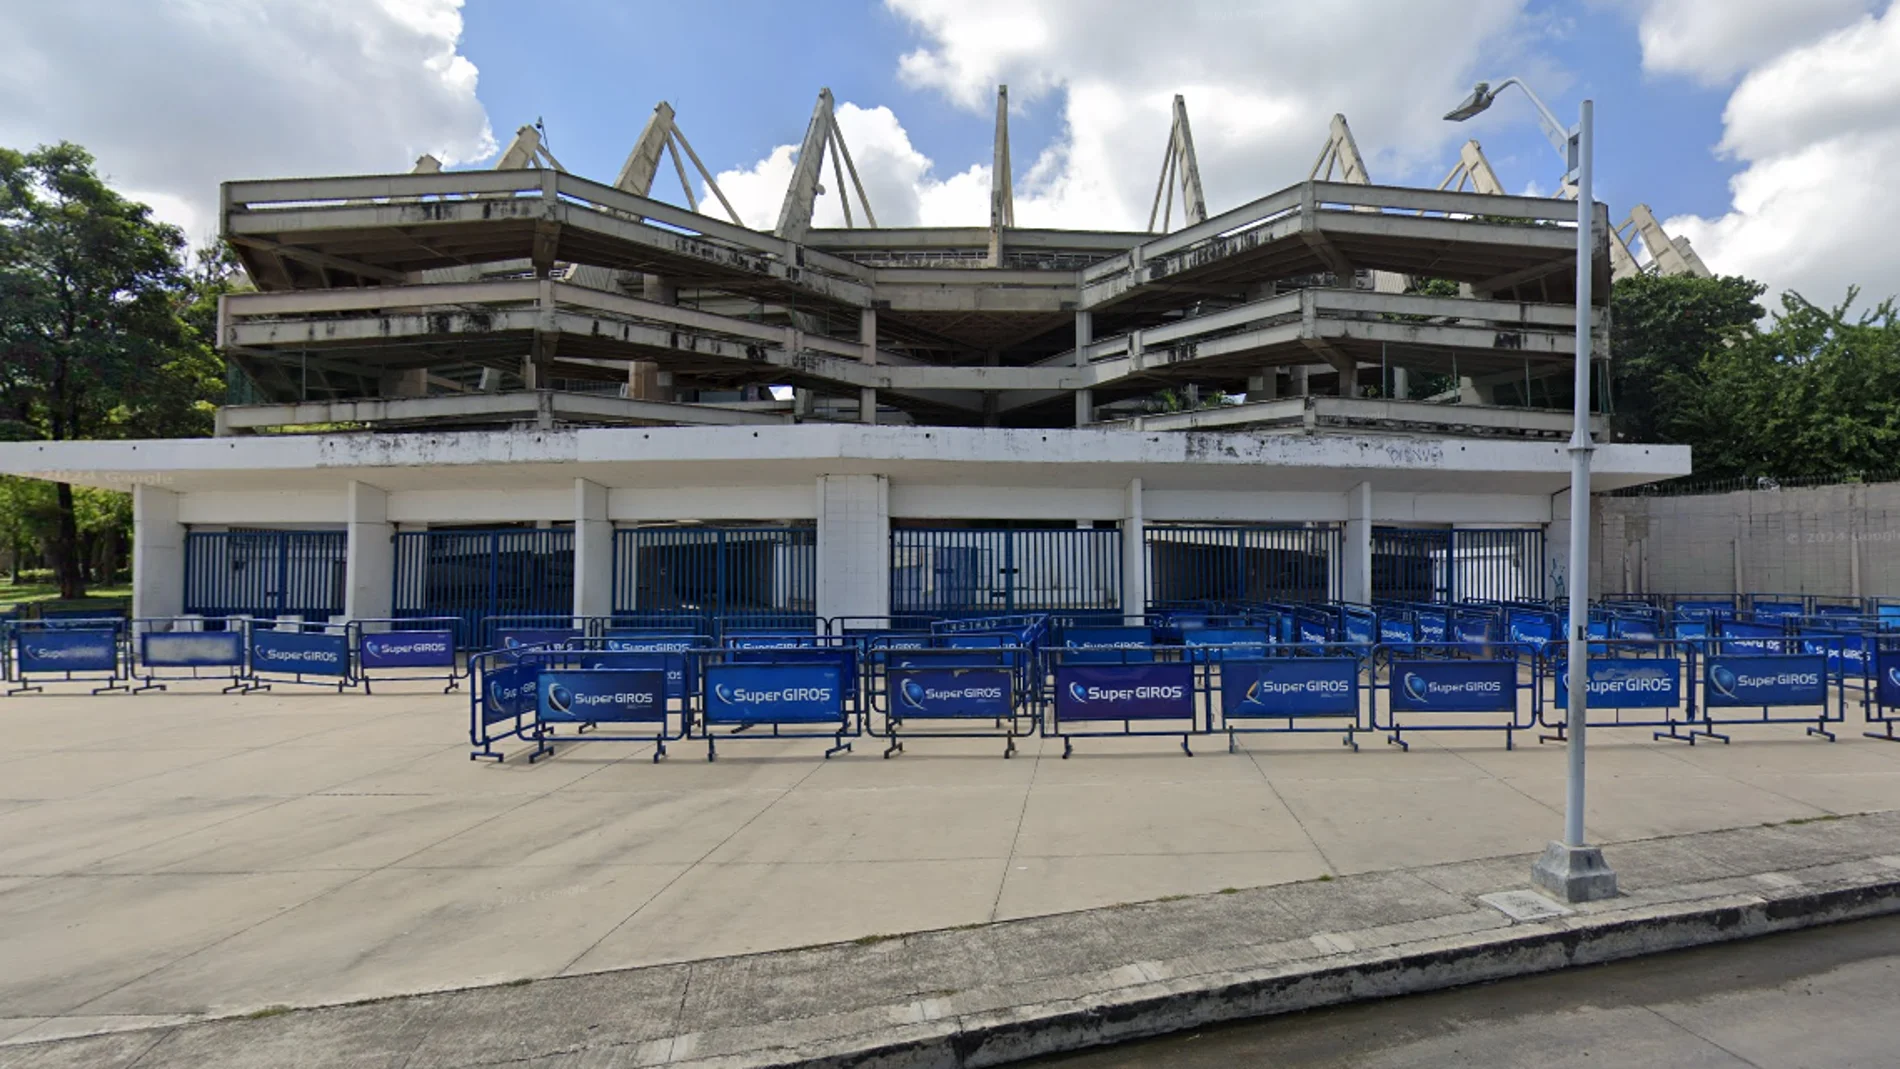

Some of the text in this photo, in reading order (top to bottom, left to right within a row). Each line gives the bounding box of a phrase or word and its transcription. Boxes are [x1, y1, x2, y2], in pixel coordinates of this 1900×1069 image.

[1263, 680, 1349, 694] SuperGIROS
[1738, 673, 1818, 688] SuperGIROS
[925, 687, 1002, 701] SuperGIROS
[1088, 686, 1183, 702] SuperGIROS
[1428, 682, 1501, 694] SuperGIROS
[574, 693, 653, 706] SuperGIROS
[734, 688, 831, 704] SuperGIROS
